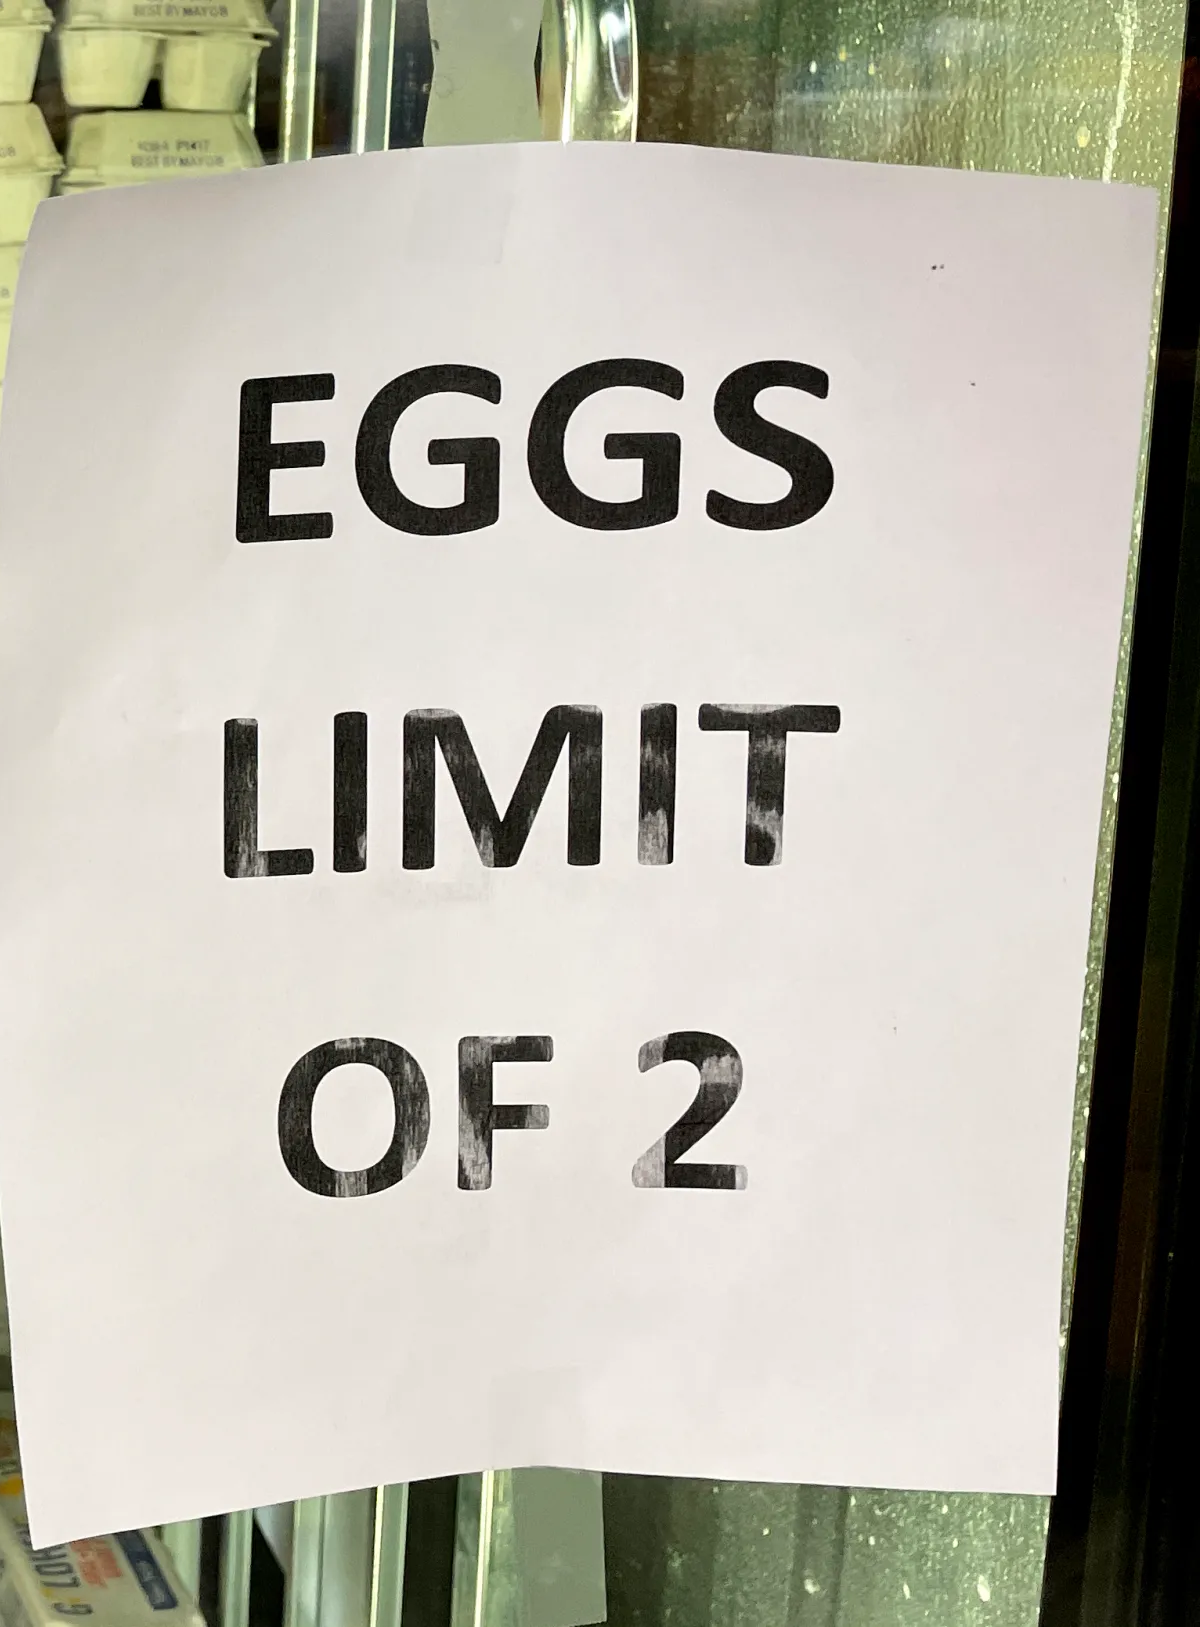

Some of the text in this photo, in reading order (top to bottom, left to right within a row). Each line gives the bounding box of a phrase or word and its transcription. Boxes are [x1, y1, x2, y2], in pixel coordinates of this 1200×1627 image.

[236, 358, 834, 543] EGGS
[224, 703, 840, 878] LIMIT
[278, 1030, 749, 1197] OF 2
